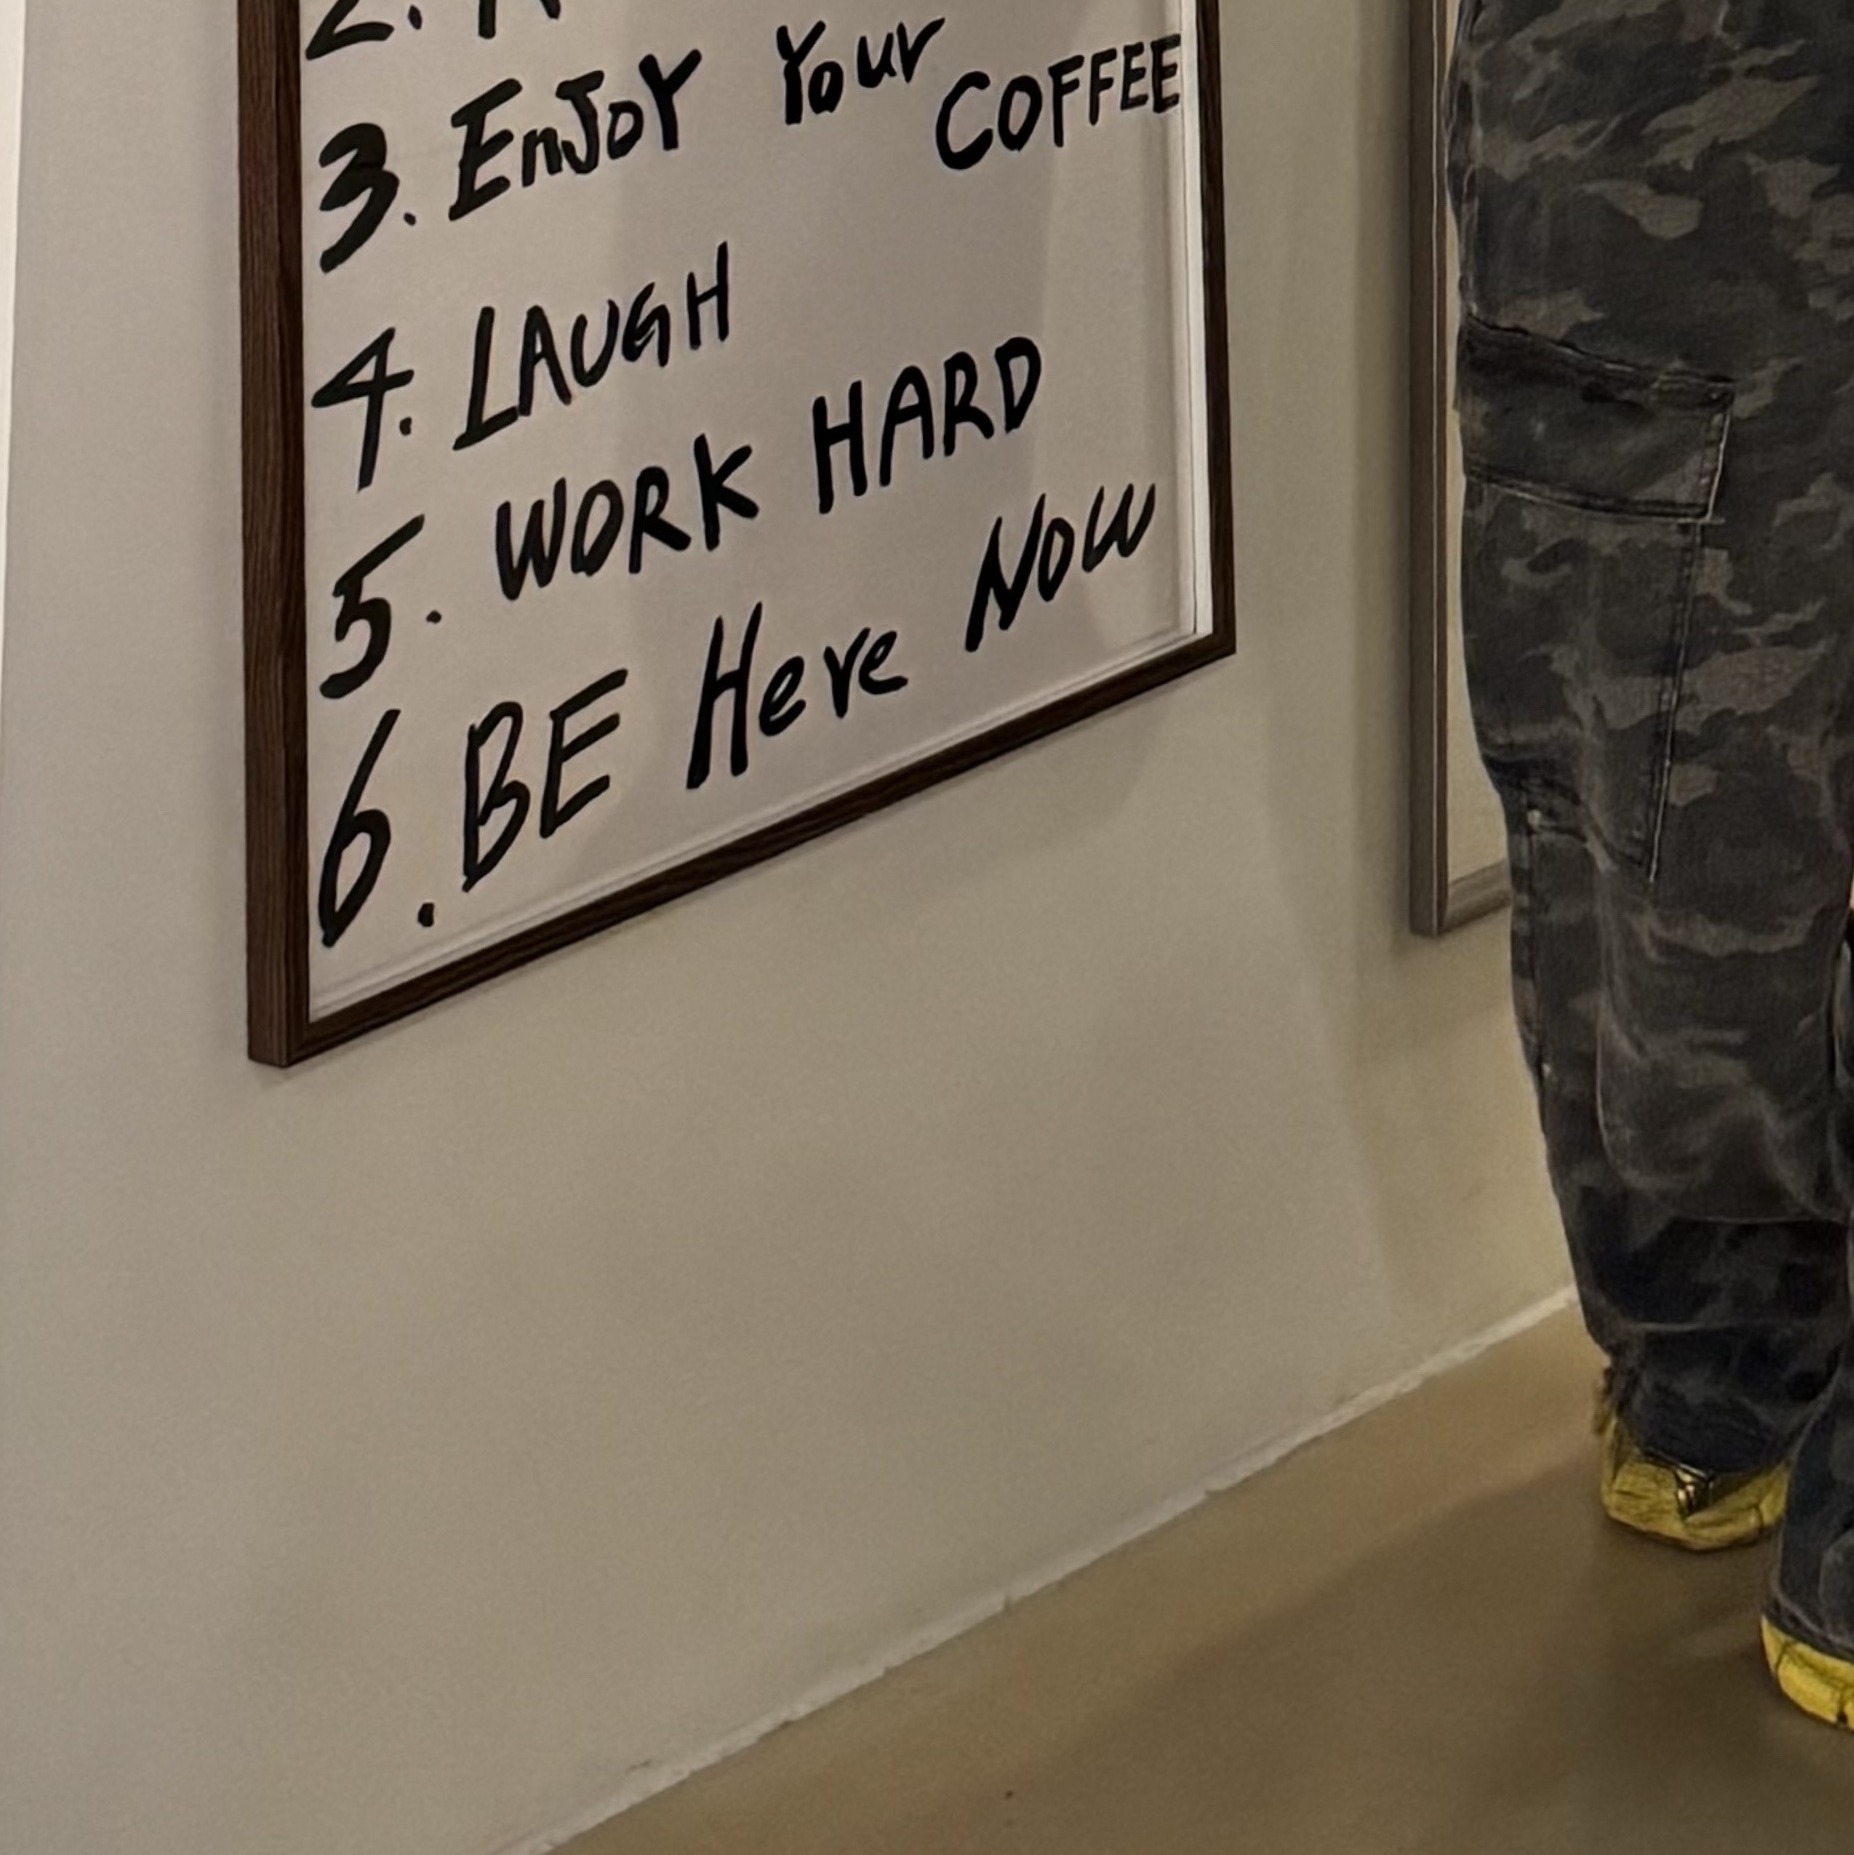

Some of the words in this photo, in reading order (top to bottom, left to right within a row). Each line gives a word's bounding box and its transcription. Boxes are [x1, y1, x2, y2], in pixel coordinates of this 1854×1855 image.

[318, 122, 417, 274] 3.
[776, 17, 946, 126] Your
[935, 33, 1182, 171] COFFEE
[310, 327, 415, 491] 4.
[452, 241, 731, 451] LAUGH
[319, 514, 443, 700] 5.
[494, 433, 760, 602] WORK
[812, 336, 1043, 515] HARD
[317, 709, 436, 949] 6.
[461, 668, 628, 893] BE
[686, 601, 909, 791] Here
